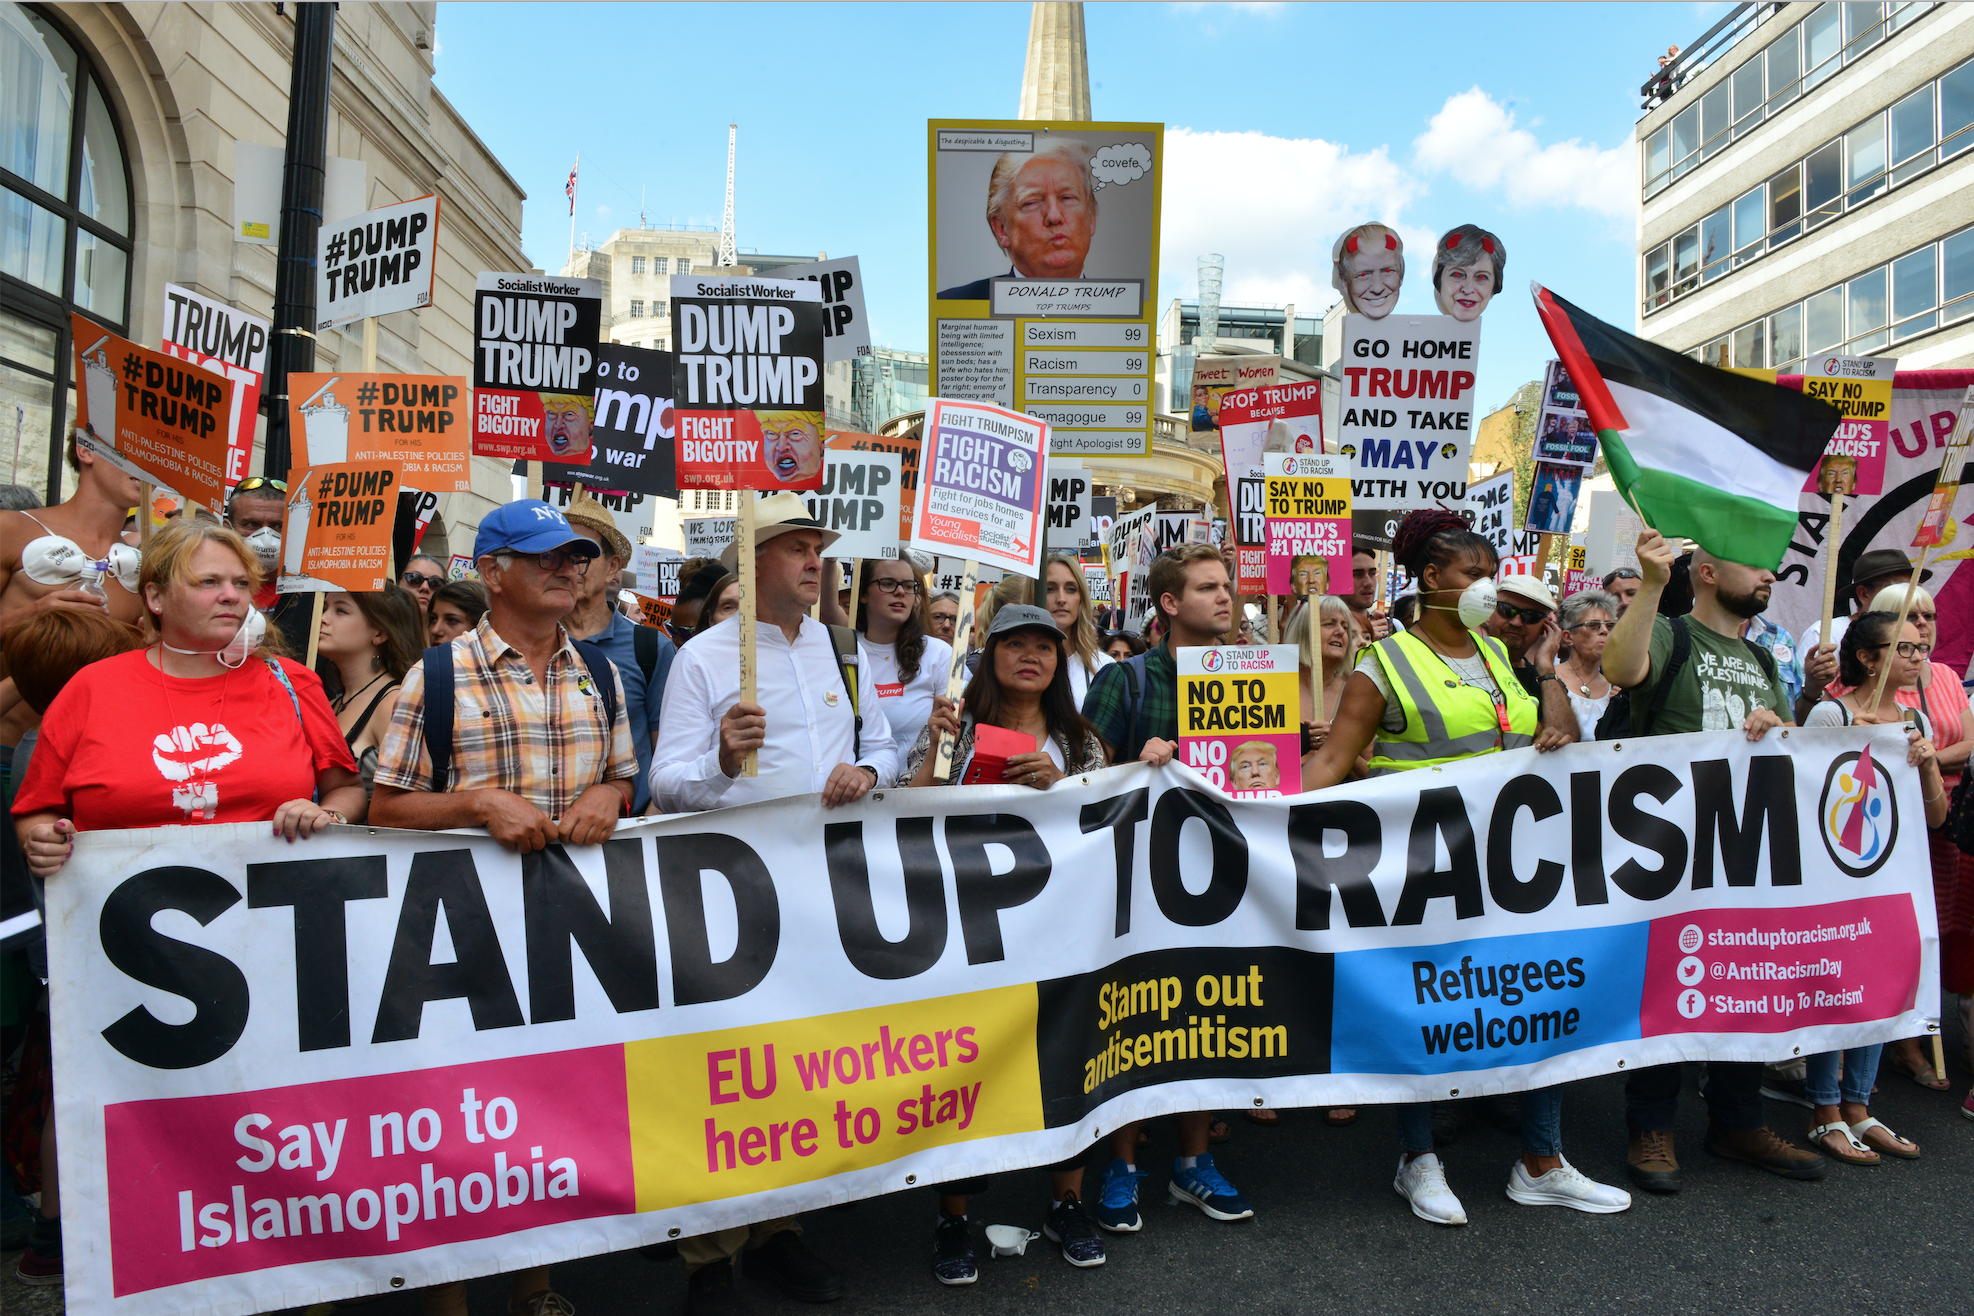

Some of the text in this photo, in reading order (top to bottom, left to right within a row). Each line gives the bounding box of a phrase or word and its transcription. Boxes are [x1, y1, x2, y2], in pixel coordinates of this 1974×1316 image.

[954, 138, 985, 146] despicable
[1102, 158, 1138, 168] covefe
[325, 212, 428, 268] #DUMP
[326, 249, 421, 303] TRUMP
[498, 278, 580, 296] Socialist Worker
[696, 283, 796, 299] Socialist Worker
[1008, 286, 1126, 298] DONALD TRUMP
[1055, 303, 1091, 311] TRUMPS
[168, 291, 266, 370] TRUMP
[481, 296, 578, 344] DUMP
[680, 304, 795, 354] DUMP
[941, 324, 972, 332] Marginal
[941, 332, 1004, 341] being with limited
[941, 341, 984, 349] intelligence;
[1028, 328, 1141, 341] Sexism 99
[856, 346, 870, 356] FOA
[1353, 339, 1472, 360] GO HOME
[479, 339, 592, 390] TRUMP
[618, 361, 640, 382] to
[1029, 358, 1142, 370] Racism 99
[1195, 367, 1274, 380] Tweet Women
[1842, 360, 1862, 369] STAND
[1852, 368, 1876, 377] RACISM
[122, 352, 222, 411] #DUMP
[680, 354, 818, 405] TRUMP
[1028, 382, 1140, 397] Transparency 0
[1344, 367, 1475, 400] TRUMP
[1808, 381, 1862, 399] SAY NO
[356, 382, 458, 408] #DUMP
[478, 393, 520, 416] FIGHT
[941, 392, 979, 400] democracy
[1222, 385, 1317, 410] STOP TRUMP
[124, 382, 216, 440] TRUMP
[1028, 410, 1142, 425] Demagogue 99
[1250, 406, 1286, 418] BECAUSE
[1342, 408, 1469, 430] AND TAKE
[1832, 400, 1885, 417] TRUMP
[359, 408, 454, 434] TRUMP
[478, 414, 540, 438] BIGOTRY
[682, 417, 734, 440] FIGHT
[940, 413, 1034, 445] FIGHT TRUMPISM
[1076, 438, 1141, 450] Apologist 99
[1890, 410, 1957, 459] UP
[121, 428, 186, 462] ANTI-PALESTINE
[188, 454, 222, 478] POLICIES
[354, 451, 465, 461] ANTI-PALESTINE POLICIES
[478, 443, 537, 456] www.swp.org.uk
[606, 448, 646, 469] war
[682, 440, 759, 463] BIGOTRY
[938, 432, 1004, 468] FIGHT
[1361, 438, 1439, 470] MAY
[1570, 445, 1588, 453] FOOL
[1824, 440, 1880, 457] RACIST
[124, 441, 182, 474] ISLAMOPHOBIA
[192, 468, 219, 490] RACISM
[432, 464, 463, 472] RACISM
[1300, 459, 1320, 467] STAND
[1310, 467, 1334, 475] RACISM
[319, 470, 394, 499] #DUMP
[455, 480, 469, 490] FOA
[684, 472, 734, 485] swp.org.uk
[934, 457, 1022, 501] RACISM
[1542, 466, 1581, 484] TIME
[1270, 481, 1324, 497] SAY NO
[1418, 481, 1467, 500] YOU
[317, 500, 385, 528] TRUMP
[933, 488, 1024, 520] Fight for jobs homes
[1270, 499, 1347, 515] TO TRUMP
[531, 505, 566, 526] NY
[929, 515, 961, 531] Young
[931, 501, 1016, 530] and services all
[690, 522, 705, 534] WE
[930, 526, 978, 544] Socialists
[980, 528, 1010, 542] socialist
[1270, 522, 1338, 539] WORLD'S
[308, 546, 386, 556] ANTI-PALESTINE POLICIES
[881, 547, 897, 558] FOA
[979, 535, 1010, 549] students
[1270, 539, 1346, 556] #1 RACIST
[308, 558, 382, 570] ISLAMOPHOBIA RACISM
[372, 578, 384, 589] FOA
[1226, 650, 1269, 660] STAND UP
[1227, 660, 1274, 670] TO RACISM
[1723, 656, 1744, 670] ARE
[1745, 661, 1762, 677] ALL
[1188, 679, 1266, 705] NO TO
[1189, 704, 1285, 730] RACISM
[1189, 740, 1227, 766] NO
[100, 755, 1803, 1069] STAND UP TO RACISM
[1708, 917, 1872, 950] standuptoracism.org.uk
[1710, 958, 1842, 980] @AntiRacismDay
[1412, 956, 1586, 1006] Refugees
[1098, 964, 1263, 1030] Stamp out
[1774, 995, 1794, 1016] Up
[1797, 992, 1811, 1009] To
[1421, 1007, 1580, 1056] welcome
[706, 1024, 979, 1106] EU workers
[1082, 1016, 1288, 1095] antisemitism
[232, 1088, 518, 1182] Say no to
[704, 1082, 982, 1173] here to stay
[178, 1146, 580, 1252] Islamophobia
